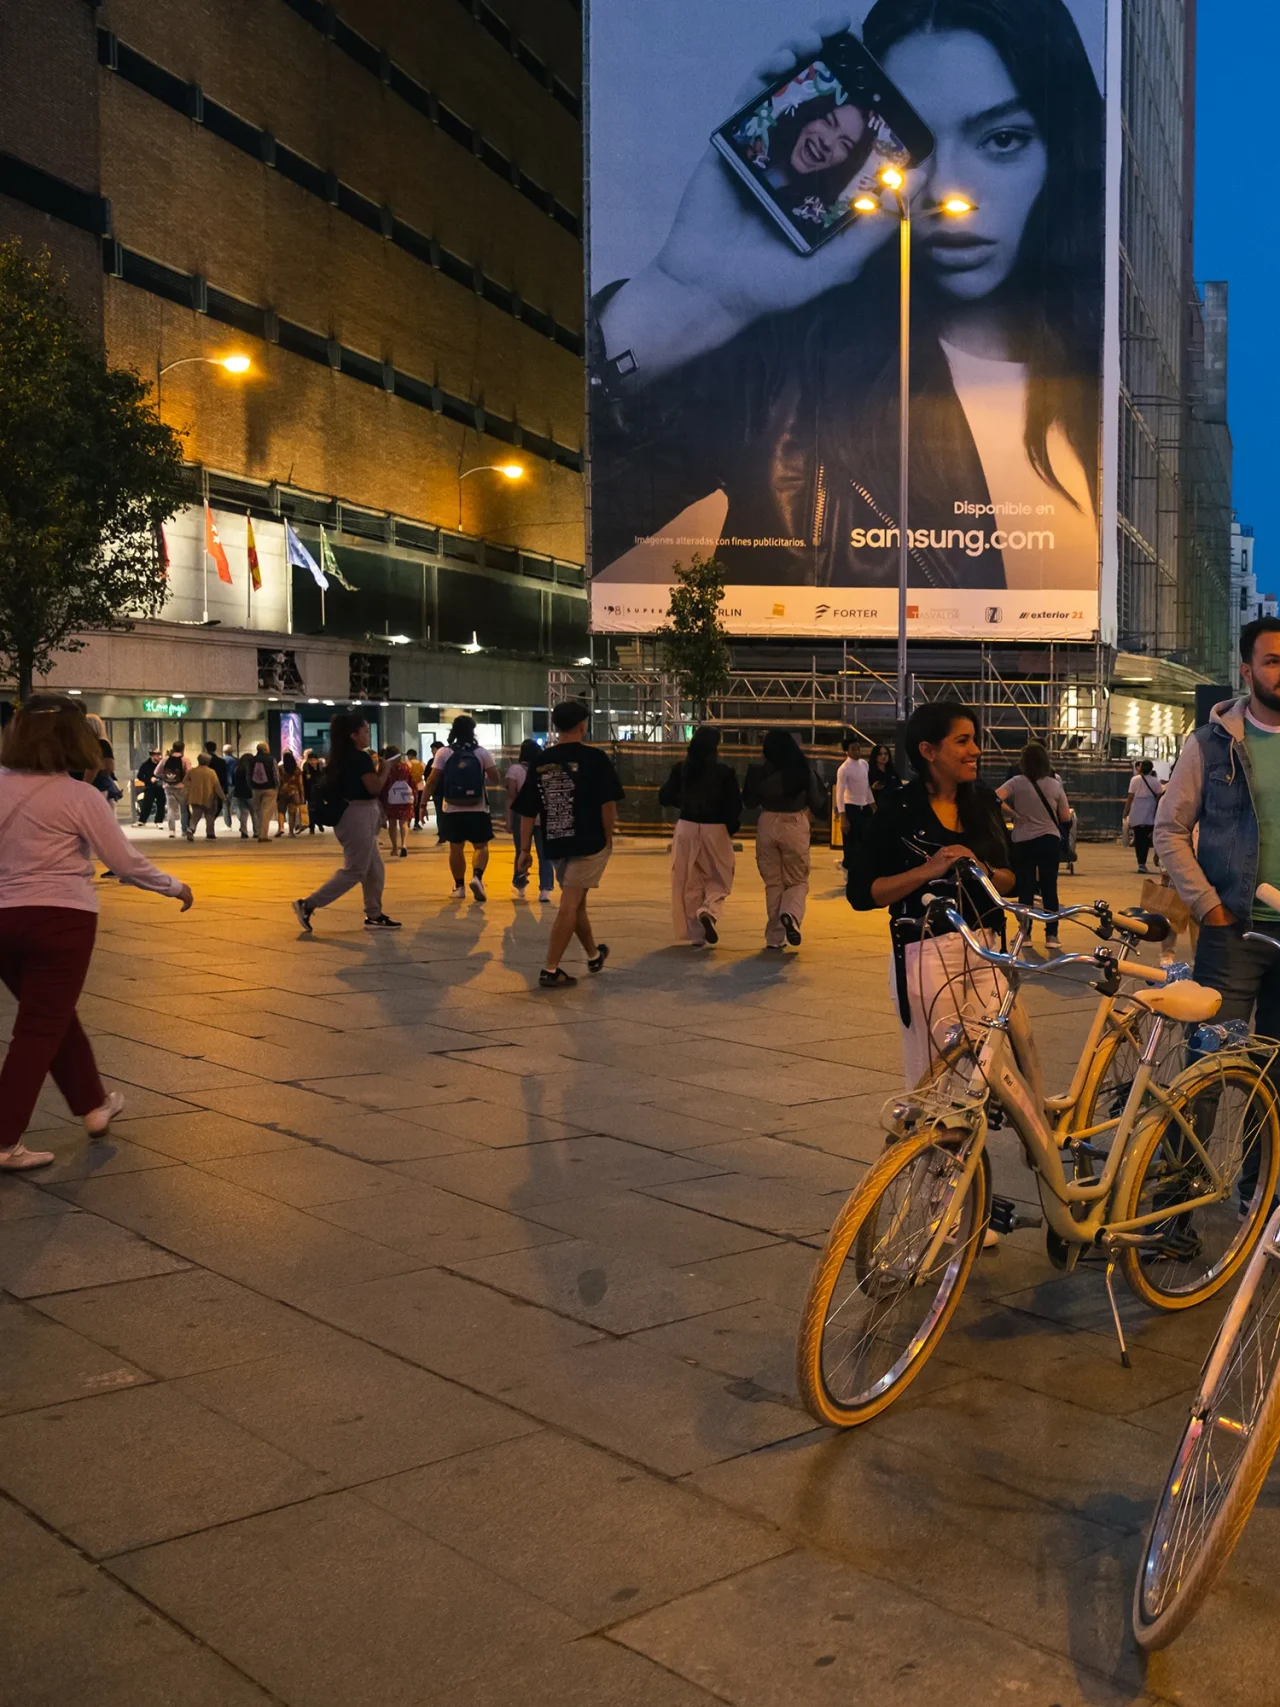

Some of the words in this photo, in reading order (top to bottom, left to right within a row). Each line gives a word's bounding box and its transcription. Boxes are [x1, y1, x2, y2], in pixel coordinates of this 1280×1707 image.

[954, 500, 1032, 519] Disponible
[1035, 503, 1055, 515] en
[634, 535, 674, 547] Imágenes
[675, 536, 714, 546] alteradas
[715, 537, 731, 546] con
[731, 536, 751, 547] fines
[753, 536, 807, 548] publicitarios.
[850, 527, 1055, 558] samsung.com
[717, 608, 742, 617] RLIN
[833, 609, 878, 618] FORTER
[1030, 611, 1070, 619] exterior
[1071, 611, 1084, 619] 21
